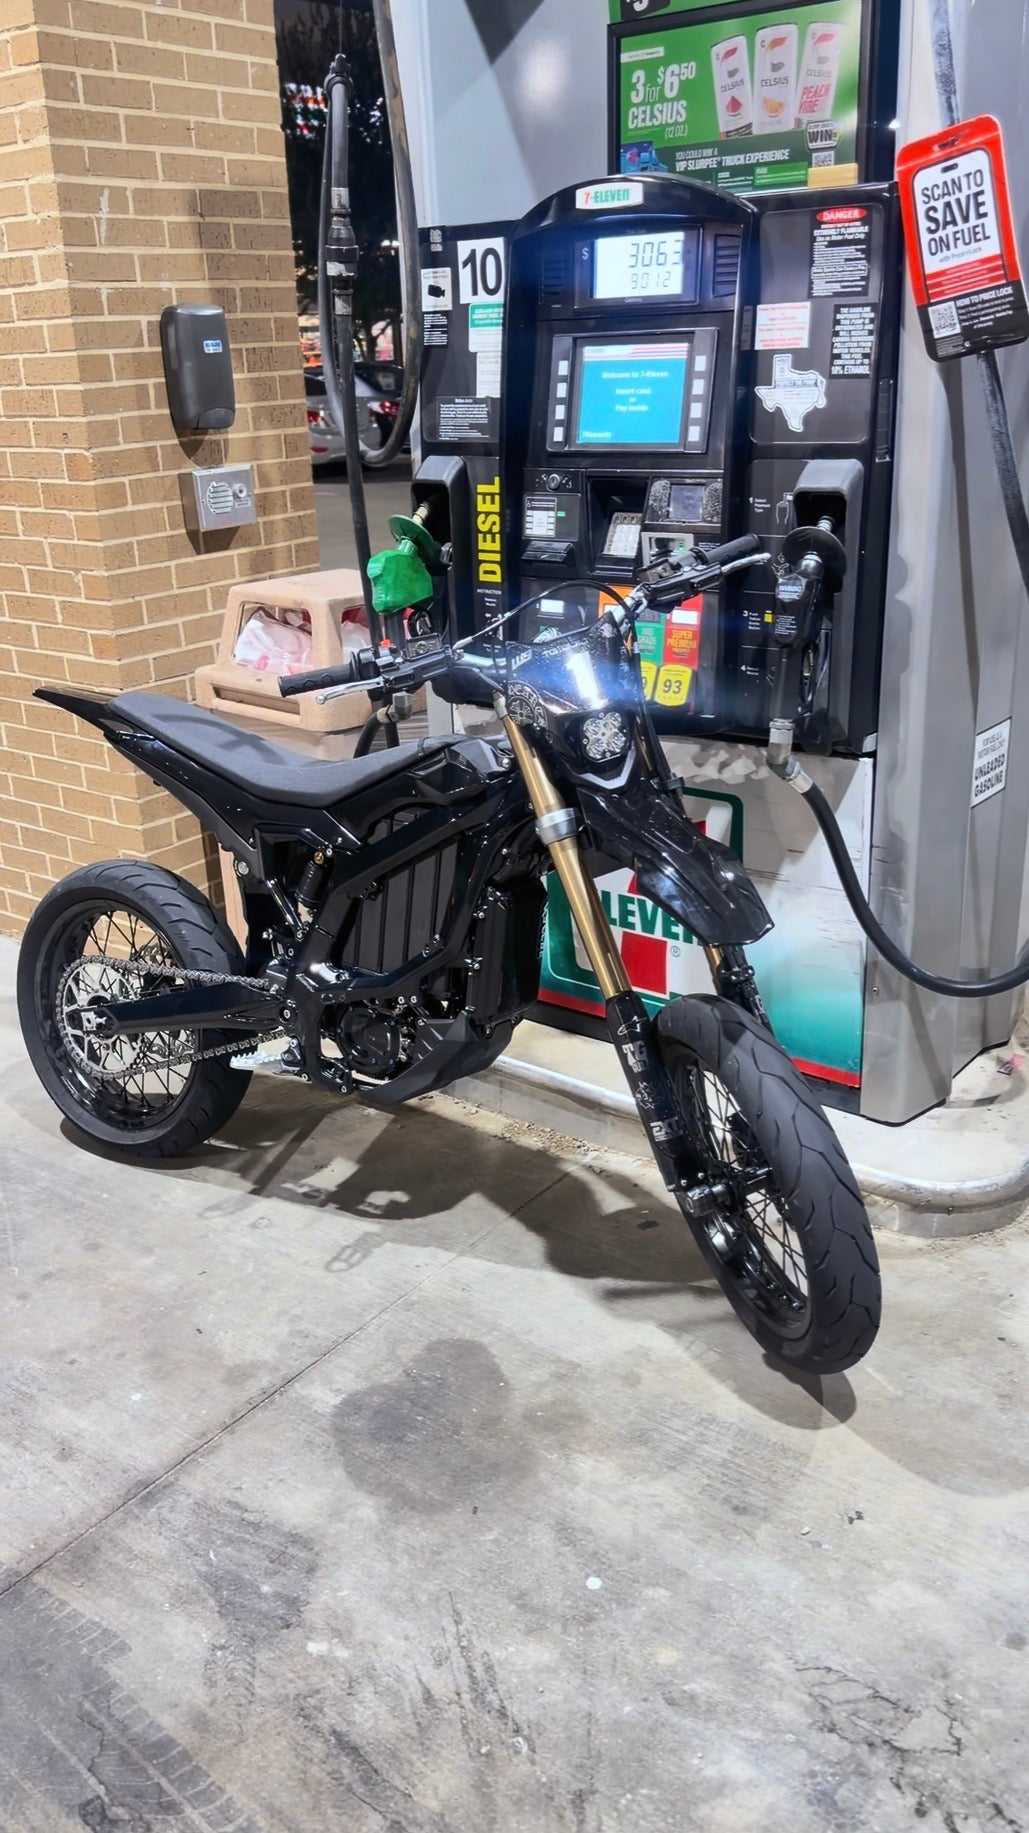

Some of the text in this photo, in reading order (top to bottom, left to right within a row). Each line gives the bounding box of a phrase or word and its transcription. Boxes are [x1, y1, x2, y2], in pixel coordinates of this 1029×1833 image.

[631, 70, 645, 103] 3
[645, 84, 661, 102] for
[720, 78, 745, 93] CELSIUS
[760, 76, 789, 88] CELSIUS
[801, 83, 832, 99] PEACH
[628, 100, 687, 129] CELSIUS
[808, 129, 833, 144] WIN
[675, 161, 687, 171] VIP
[722, 154, 745, 167] TRUCK
[746, 149, 790, 164] EXPERIENCE
[921, 169, 984, 205] SCAN TO
[822, 209, 860, 221] DANGER
[924, 189, 988, 235] SAVE
[928, 222, 991, 256] ON FUEL
[462, 247, 502, 296] 10
[602, 371, 631, 379] Welcome
[831, 366, 843, 375] 10%
[477, 476, 502, 583] DIESEL
[671, 630, 693, 639] SUPER
[663, 679, 682, 694] 93
